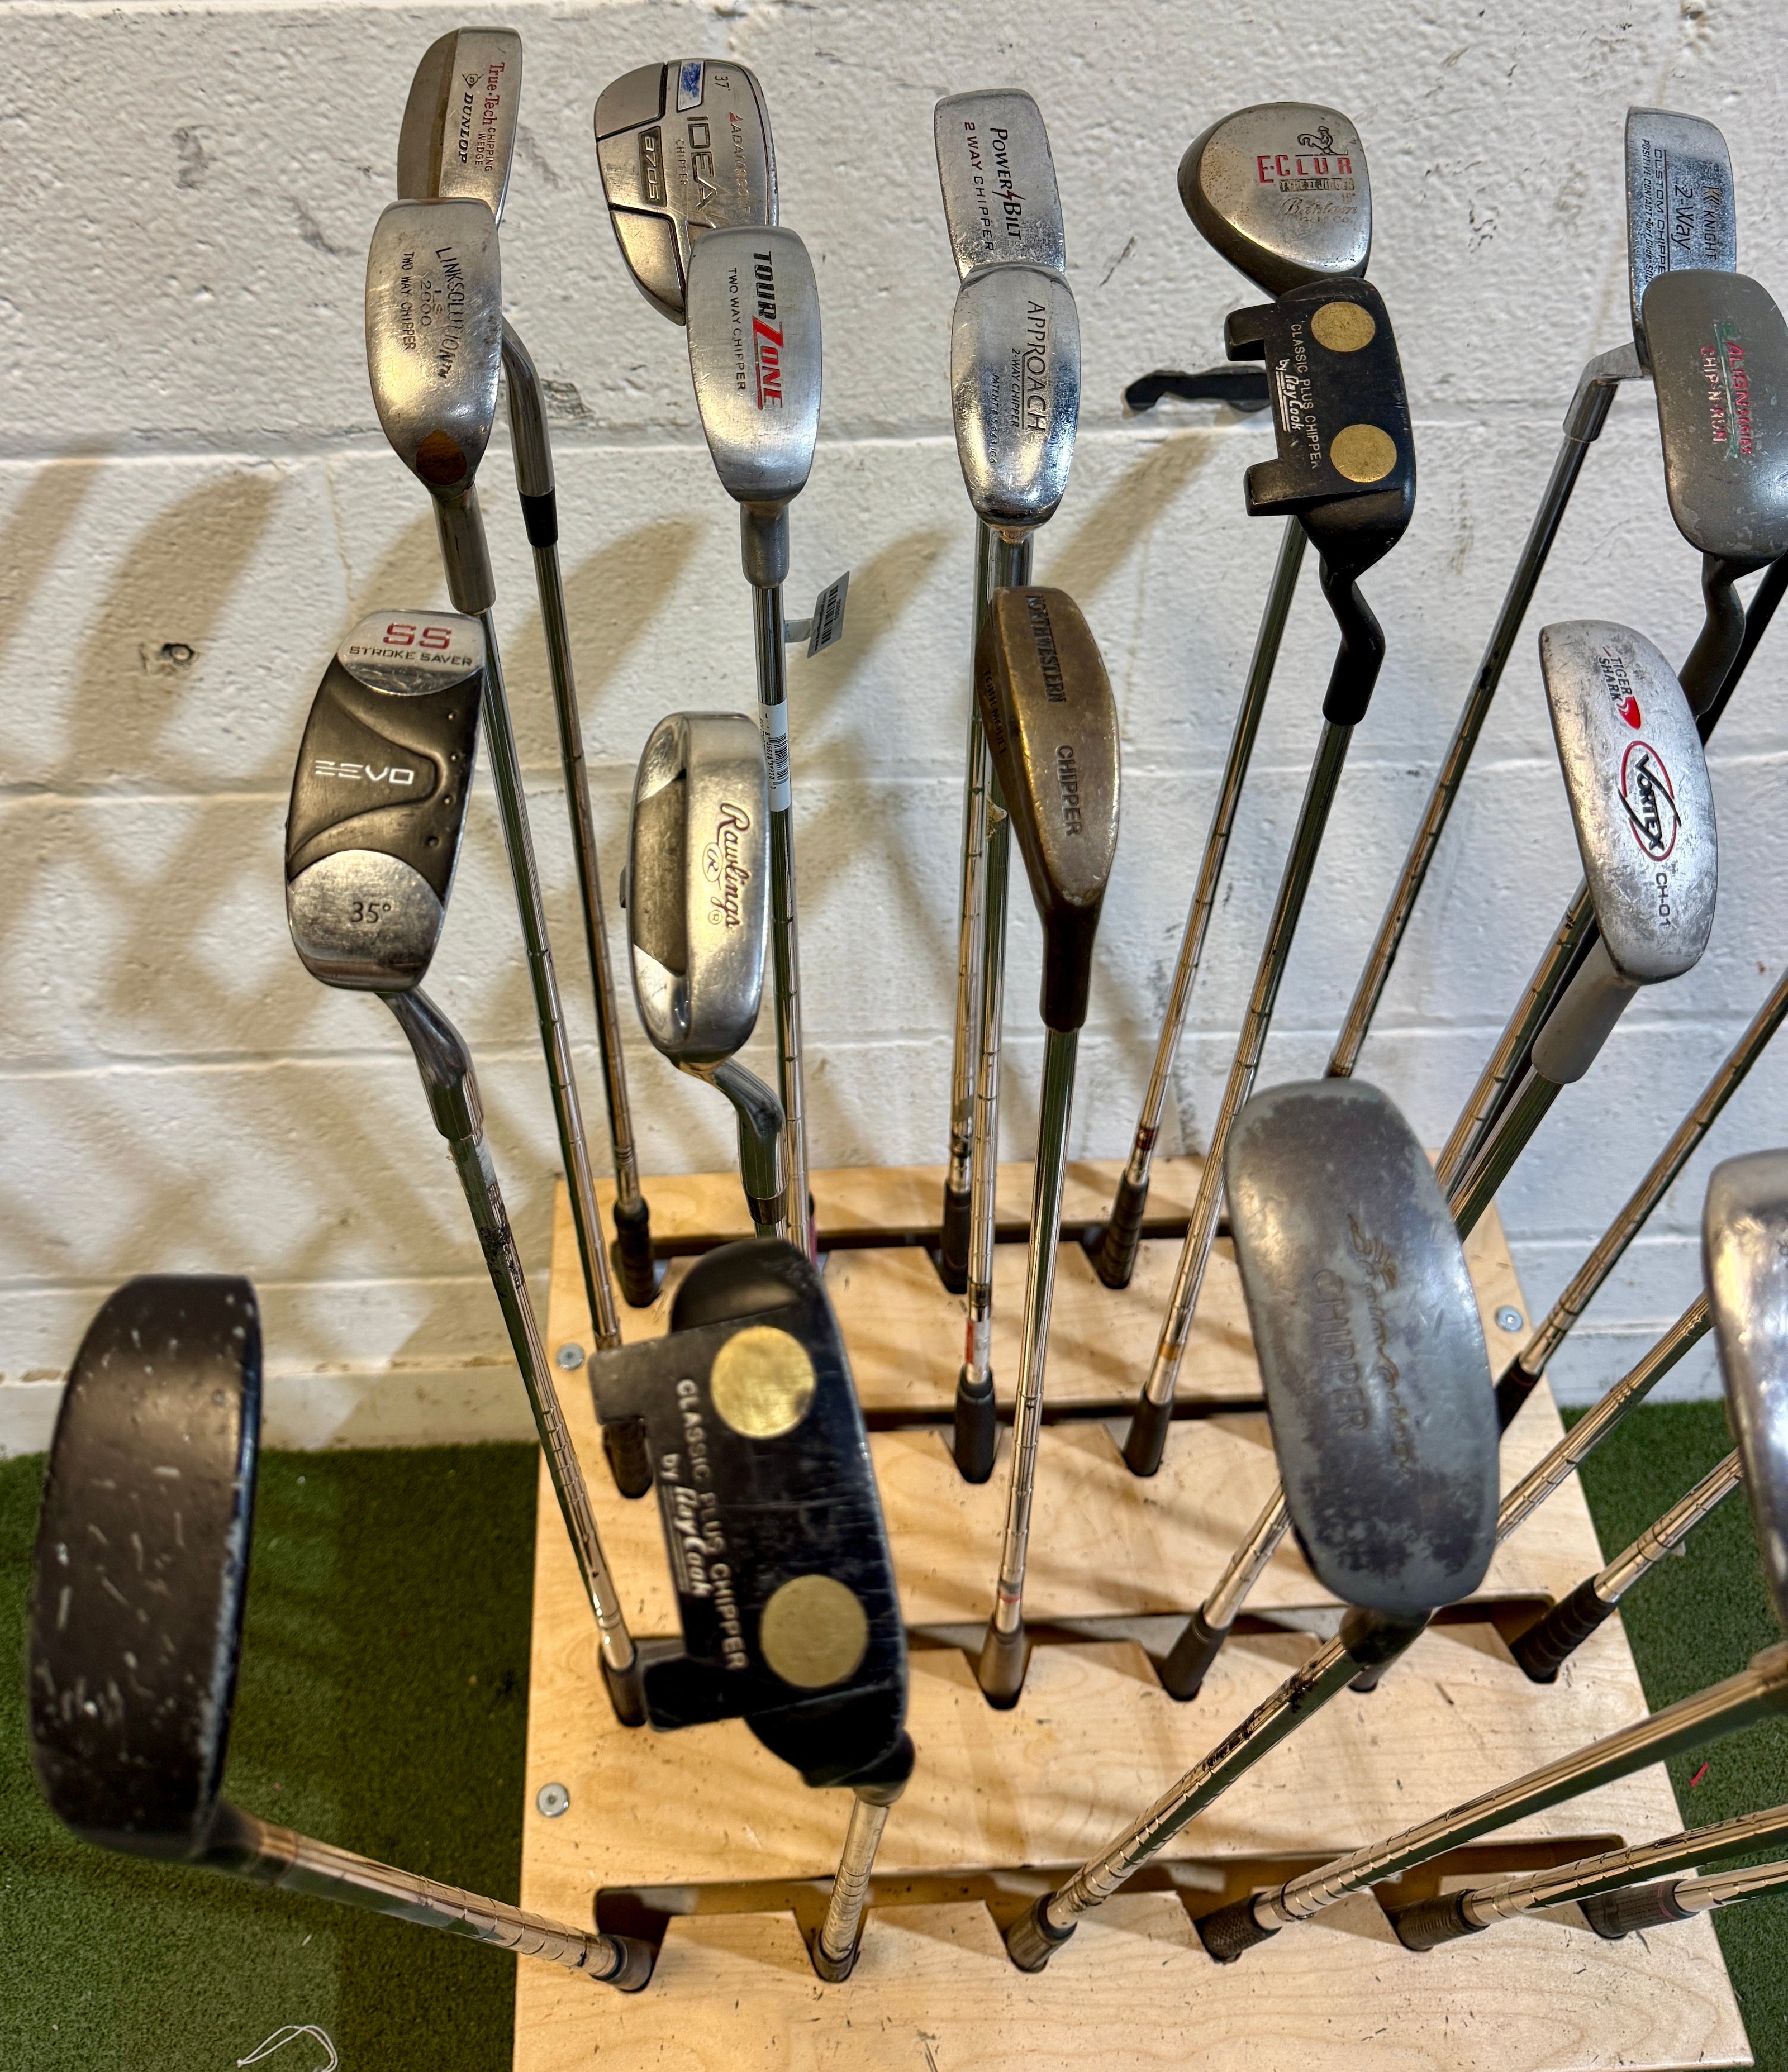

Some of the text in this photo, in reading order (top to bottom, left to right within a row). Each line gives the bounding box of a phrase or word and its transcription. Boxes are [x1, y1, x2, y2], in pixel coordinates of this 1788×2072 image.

[458, 92, 474, 164] DUNLOP
[475, 133, 486, 165] WEDGE
[484, 127, 496, 172] CHIPPING
[676, 138, 689, 186] CHIPPER
[687, 116, 717, 212] IDEA
[1642, 139, 1651, 175] POSITIVE
[964, 122, 995, 251] 2 WAY CHIPPER
[1644, 178, 1652, 216] CONTACT
[1654, 149, 1667, 274] CUSTOM CHIPPE
[1003, 201, 1022, 240] BILT
[1671, 185, 1695, 250] 2-Way
[1704, 211, 1718, 261] KNIGHT
[1646, 264, 1654, 283] SOL
[401, 251, 416, 351] TWO WAY CHIPPER
[420, 280, 432, 326] 2000
[728, 268, 746, 390] TWO WAY CHIPPER
[1291, 323, 1309, 373] CLASSIC
[1011, 348, 1021, 427] 2-WAY CHIPPER
[1026, 300, 1046, 434] APPROACH
[1276, 359, 1290, 371] by
[1725, 340, 1750, 407] ALIGN
[992, 374, 1000, 408] PATENT
[1299, 379, 1314, 410] PLUS
[349, 646, 474, 666] STROKE SAVER
[383, 622, 453, 650] SS
[1025, 594, 1067, 703] NORTHWESTERN
[1599, 657, 1623, 705] SHARK
[1609, 656, 1633, 696] TIGER
[1055, 745, 1082, 837] CHIPPER
[711, 800, 753, 929] Rawlings
[1655, 872, 1672, 929] CH-01
[1311, 1269, 1367, 1431] CHIPPER
[661, 1453, 680, 1480] by
[676, 1378, 750, 1670] CLASSIC PLUS CHIPPER
